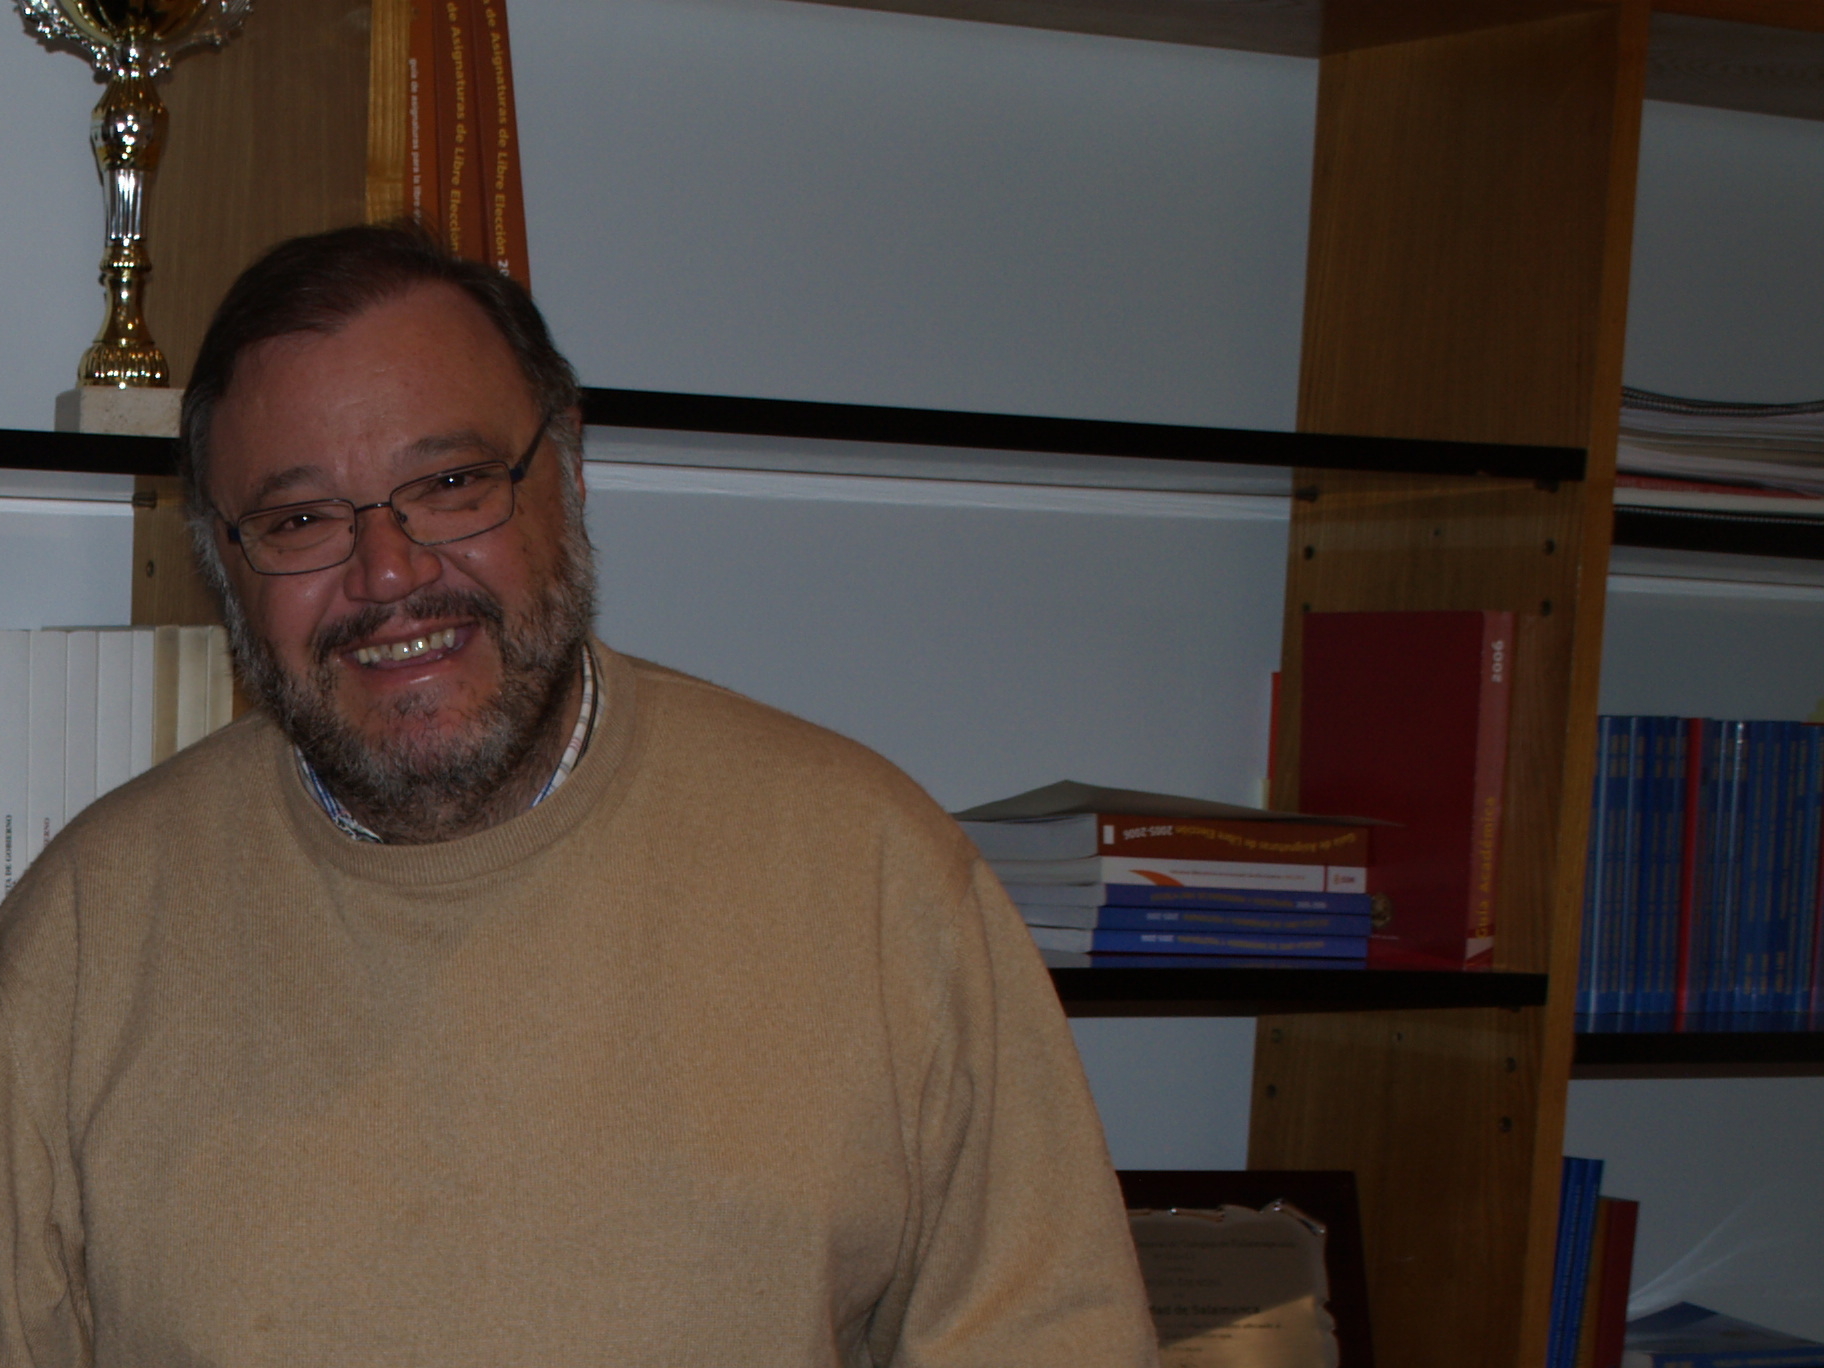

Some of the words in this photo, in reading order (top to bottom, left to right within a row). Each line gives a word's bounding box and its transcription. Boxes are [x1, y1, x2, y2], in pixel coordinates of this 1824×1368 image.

[446, 2, 459, 22] de
[485, 8, 497, 28] de
[451, 26, 466, 120] Asignaturas
[490, 32, 507, 124] Asignaturas
[455, 123, 467, 143] de
[498, 128, 509, 149] de
[451, 147, 465, 186] Libre
[495, 151, 508, 190] Libre
[494, 193, 507, 256] Elección
[1491, 640, 1505, 683] 2006
